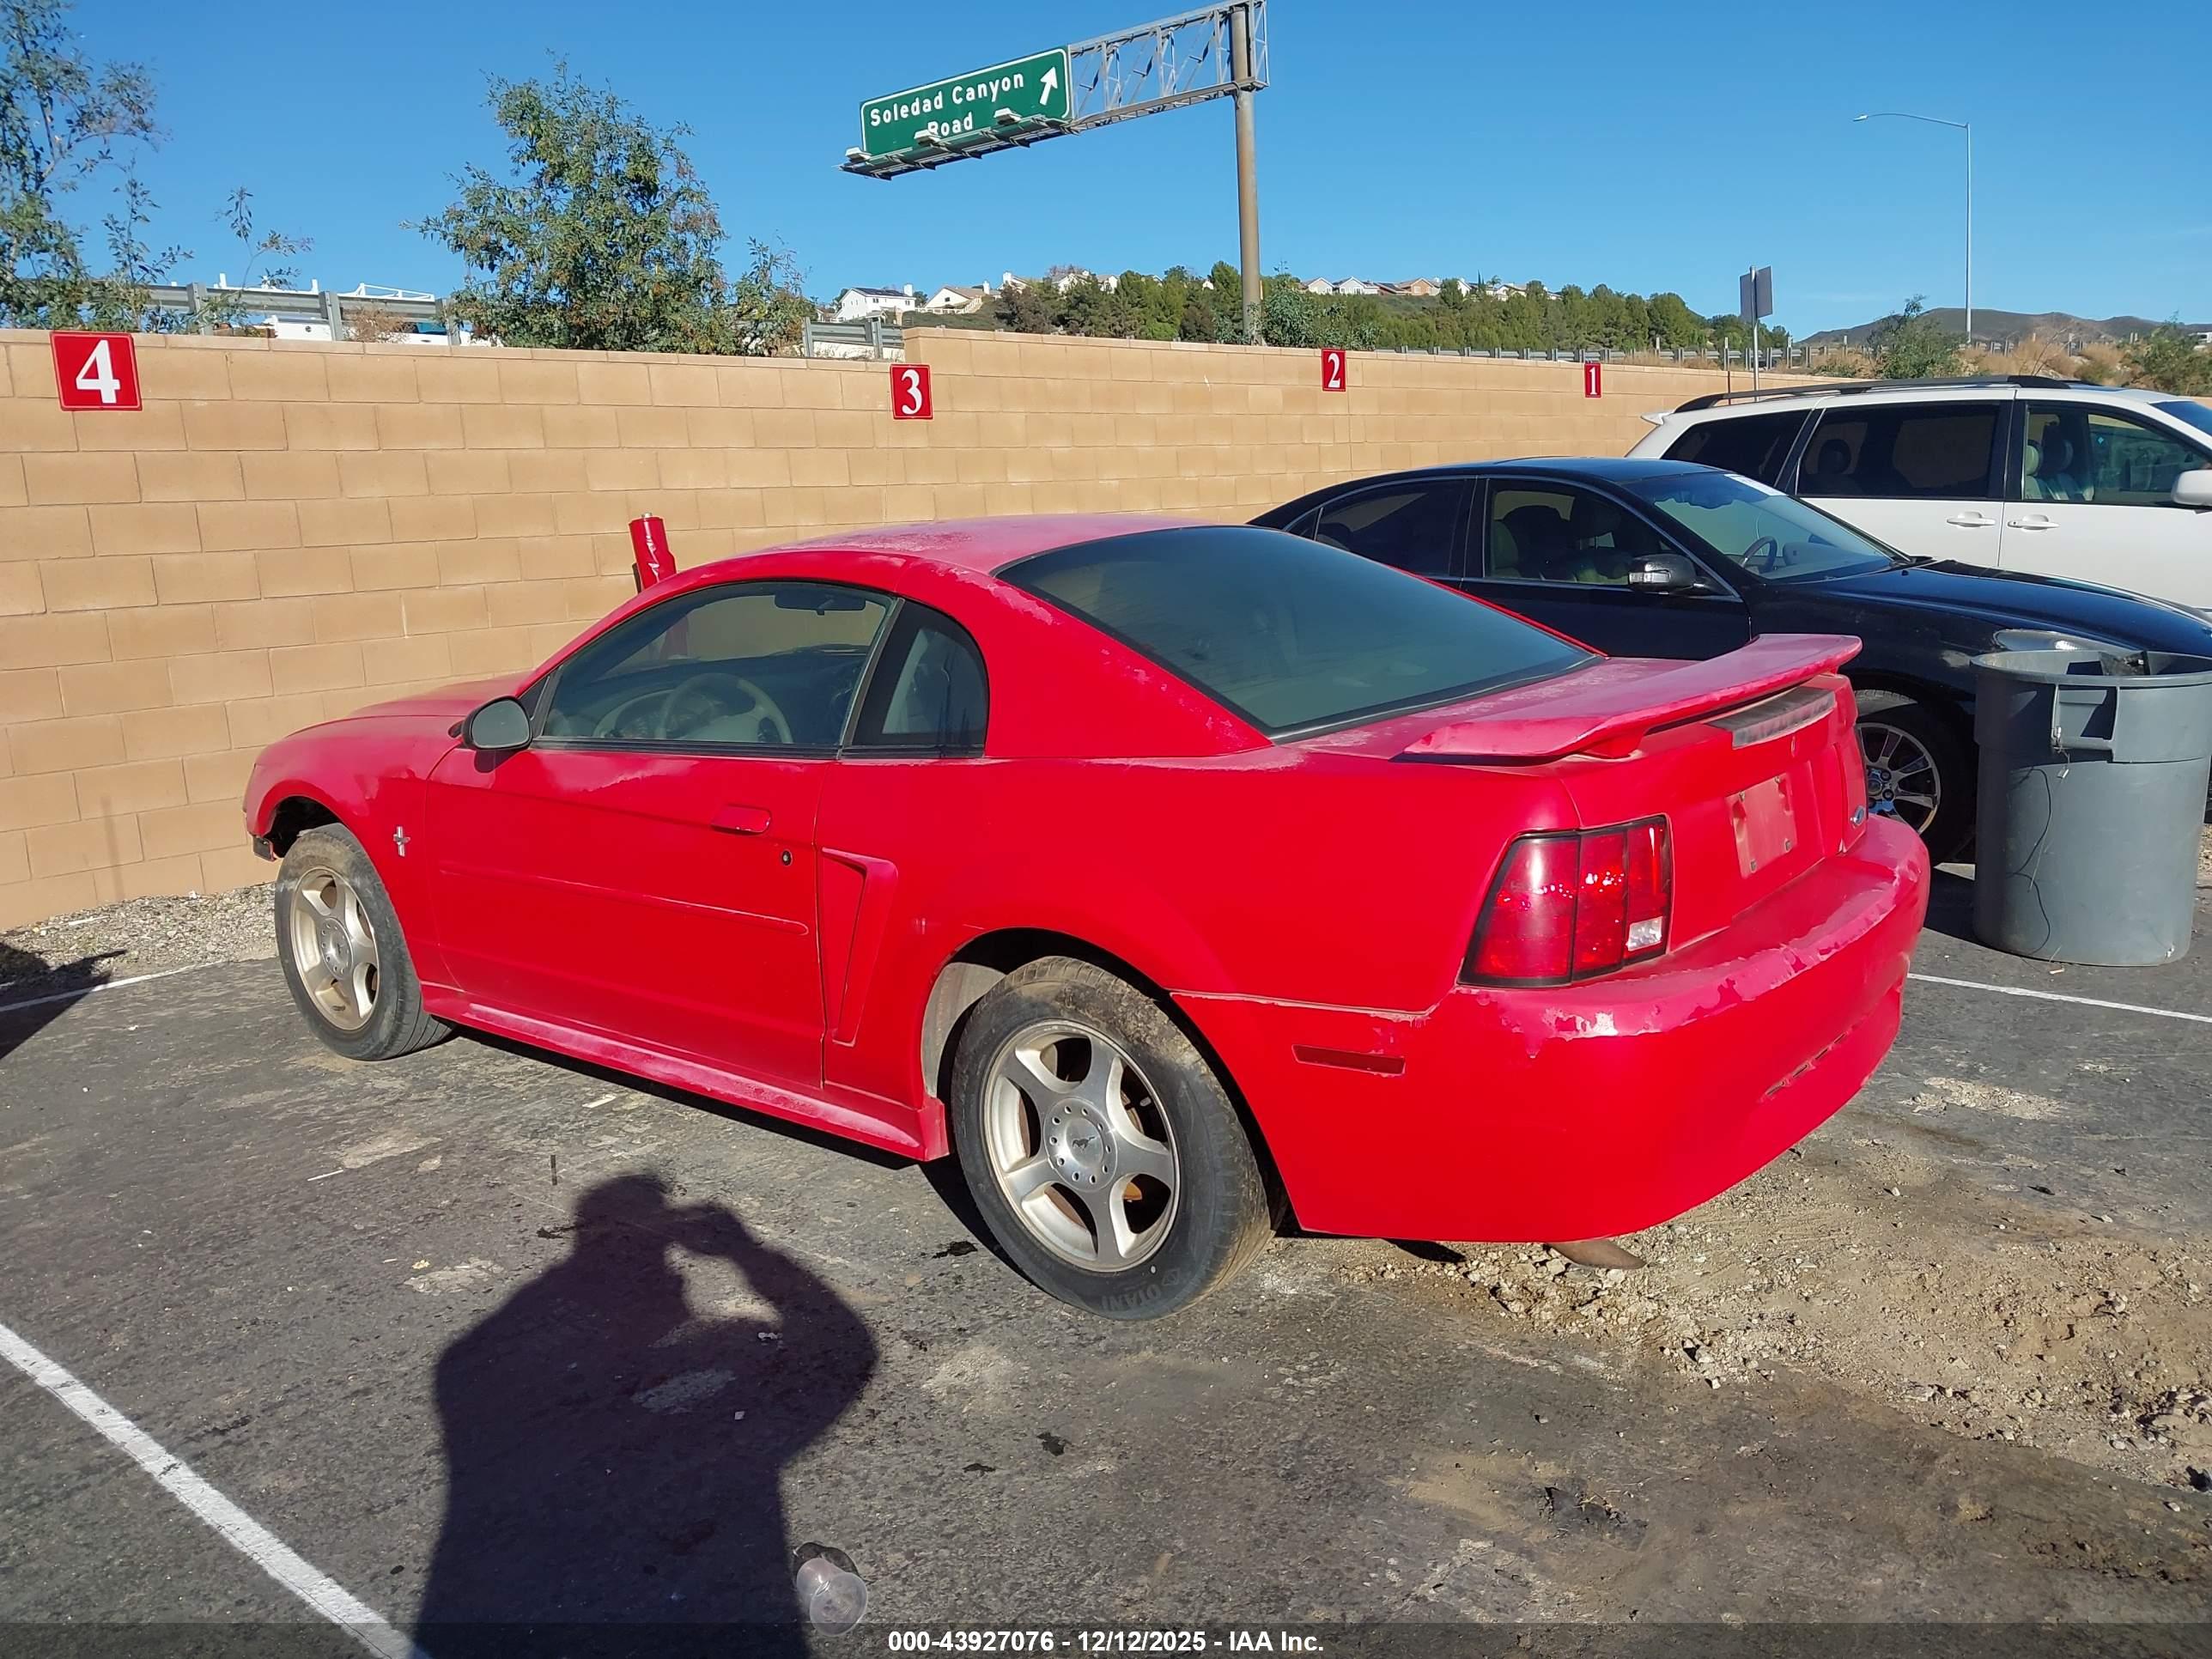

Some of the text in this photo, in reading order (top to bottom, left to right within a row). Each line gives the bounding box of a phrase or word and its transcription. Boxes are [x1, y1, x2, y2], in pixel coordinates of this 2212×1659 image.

[870, 72, 1024, 126] Soledad Canyon
[927, 111, 973, 137] Road
[76, 339, 120, 404] 4
[1328, 352, 1341, 388] 2
[1589, 366, 1598, 395] 1
[901, 368, 923, 415] 3
